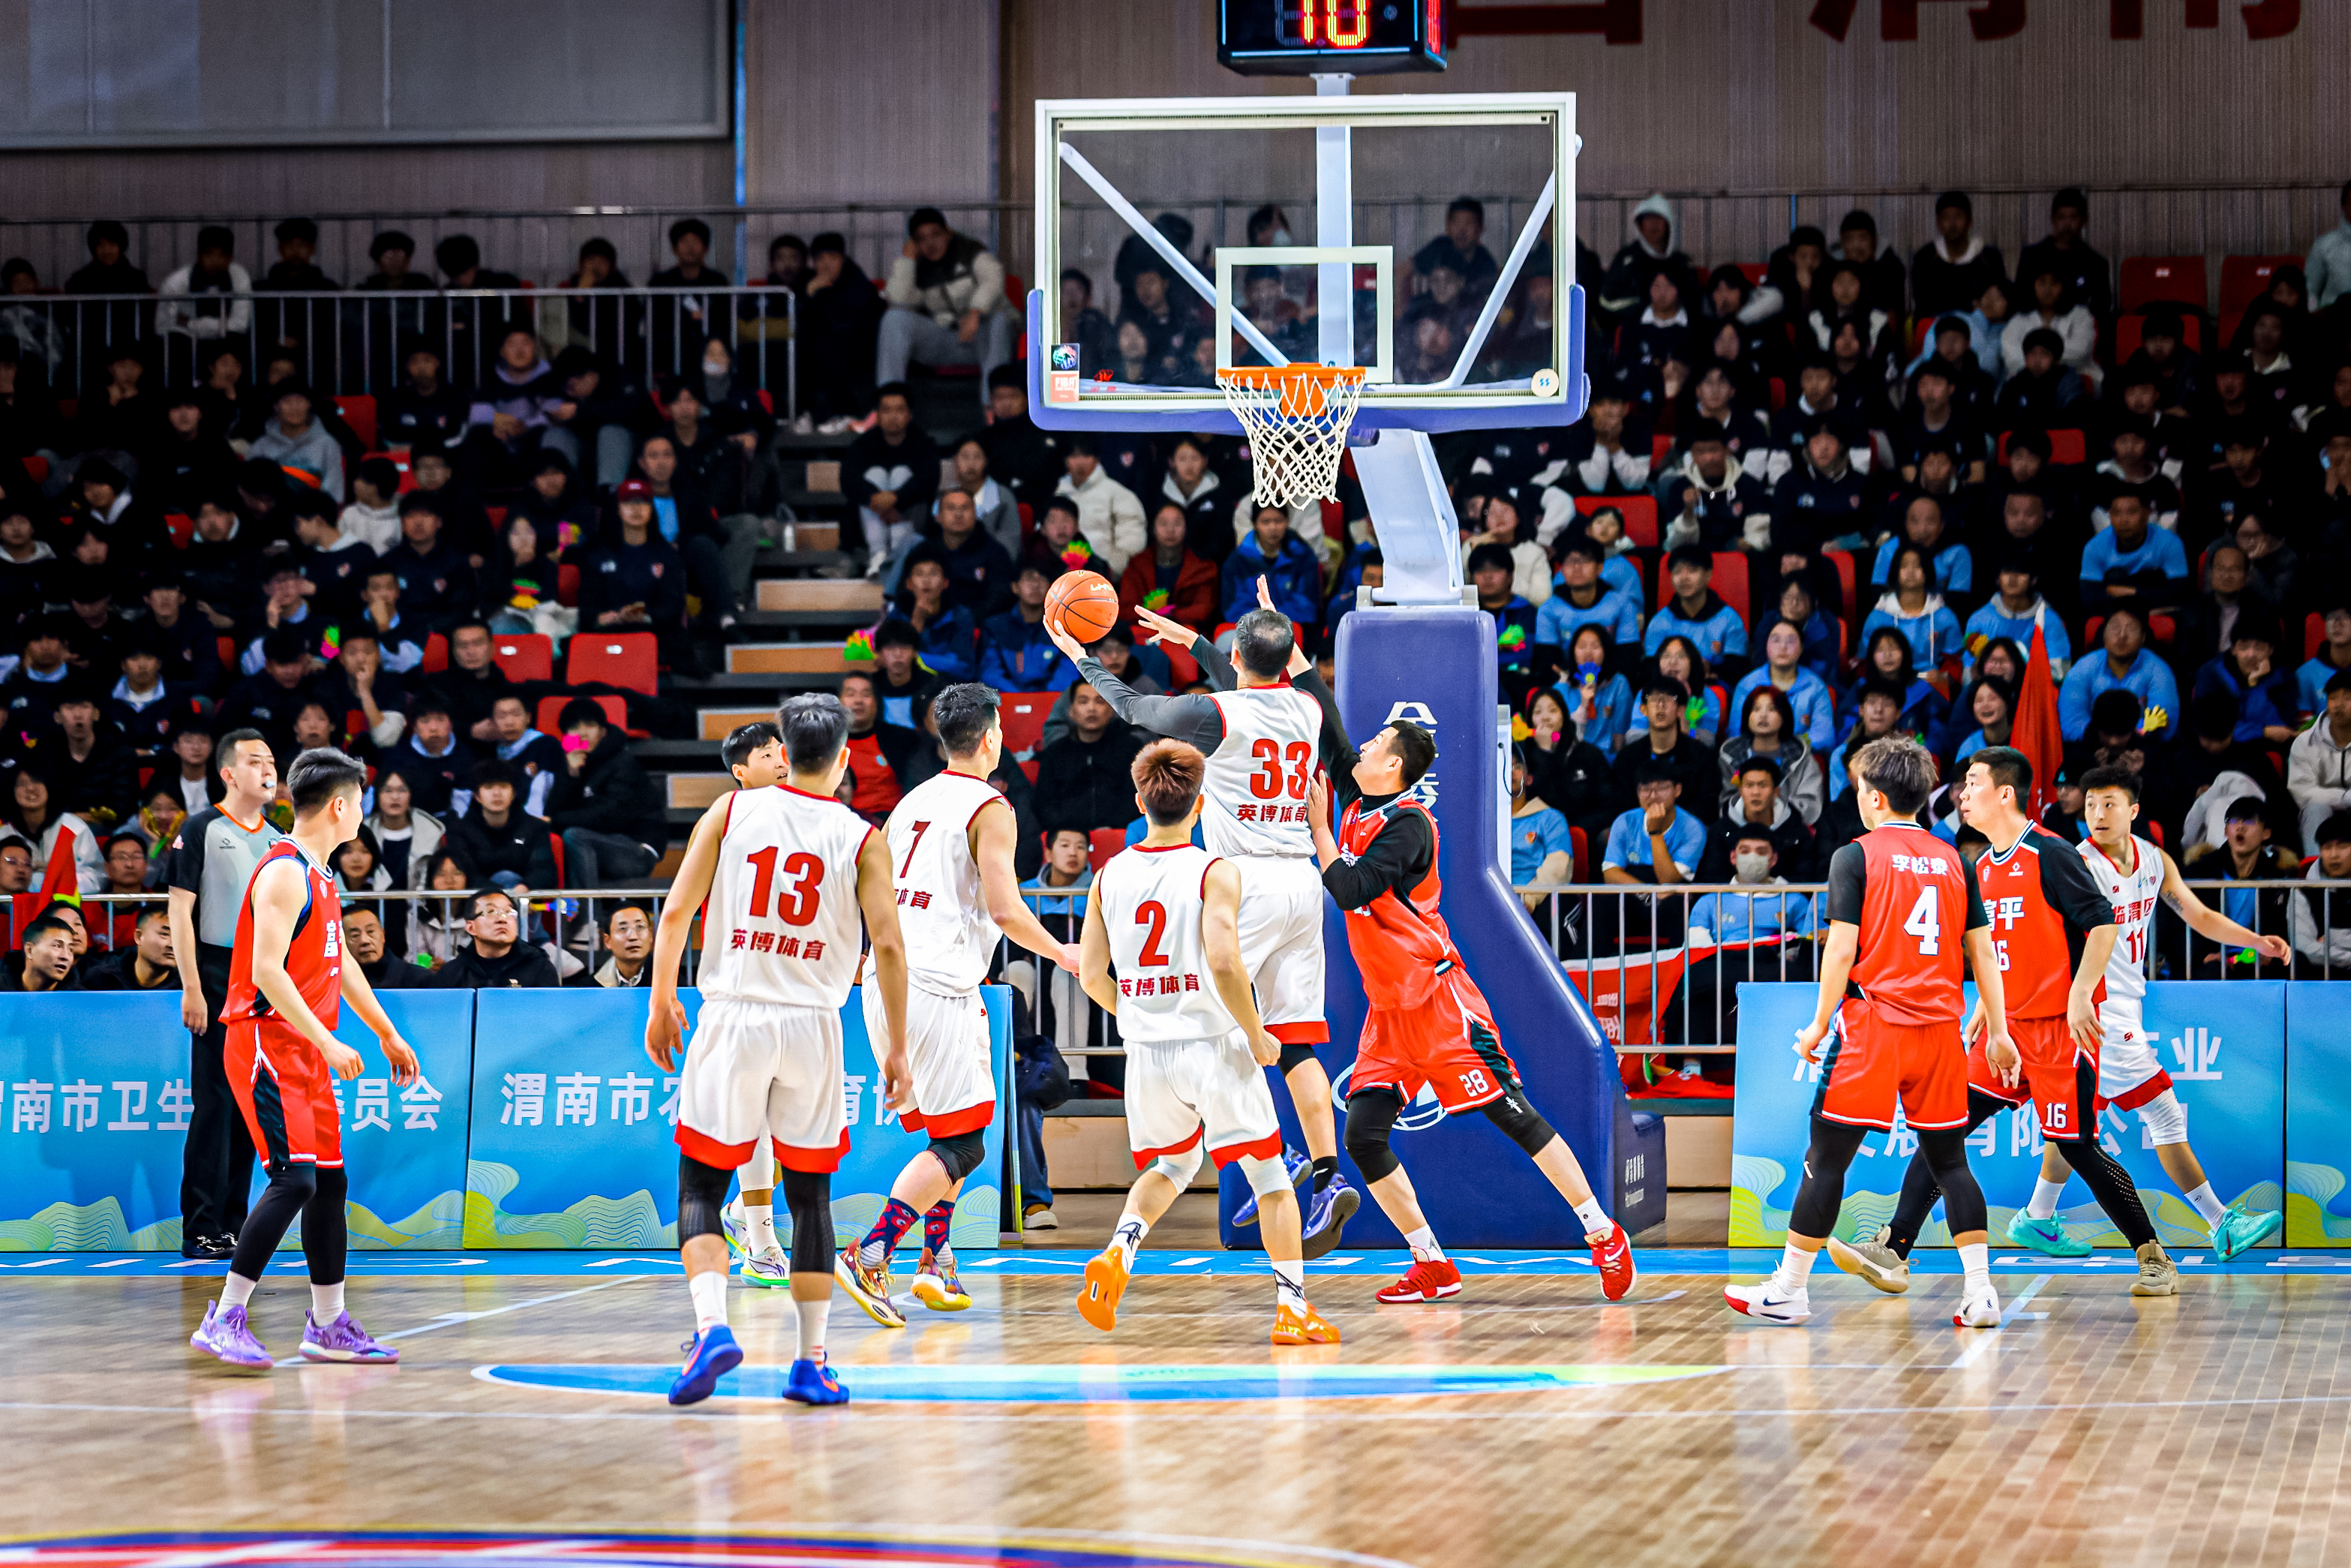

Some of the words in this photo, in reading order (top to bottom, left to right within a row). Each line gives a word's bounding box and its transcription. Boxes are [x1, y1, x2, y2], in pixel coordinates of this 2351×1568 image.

[1303, 0, 1367, 47] 10
[1250, 738, 1312, 800] 33
[899, 820, 932, 879] 7
[746, 846, 825, 927] 13
[894, 888, 933, 910] 体育
[1135, 900, 1169, 967] 2
[1903, 885, 1941, 957] 4
[731, 928, 827, 961] 英博体育
[2126, 927, 2144, 965] 11
[1118, 973, 1200, 998] 英博体育
[1458, 1068, 1490, 1098] 28
[2045, 1102, 2067, 1129] 16
